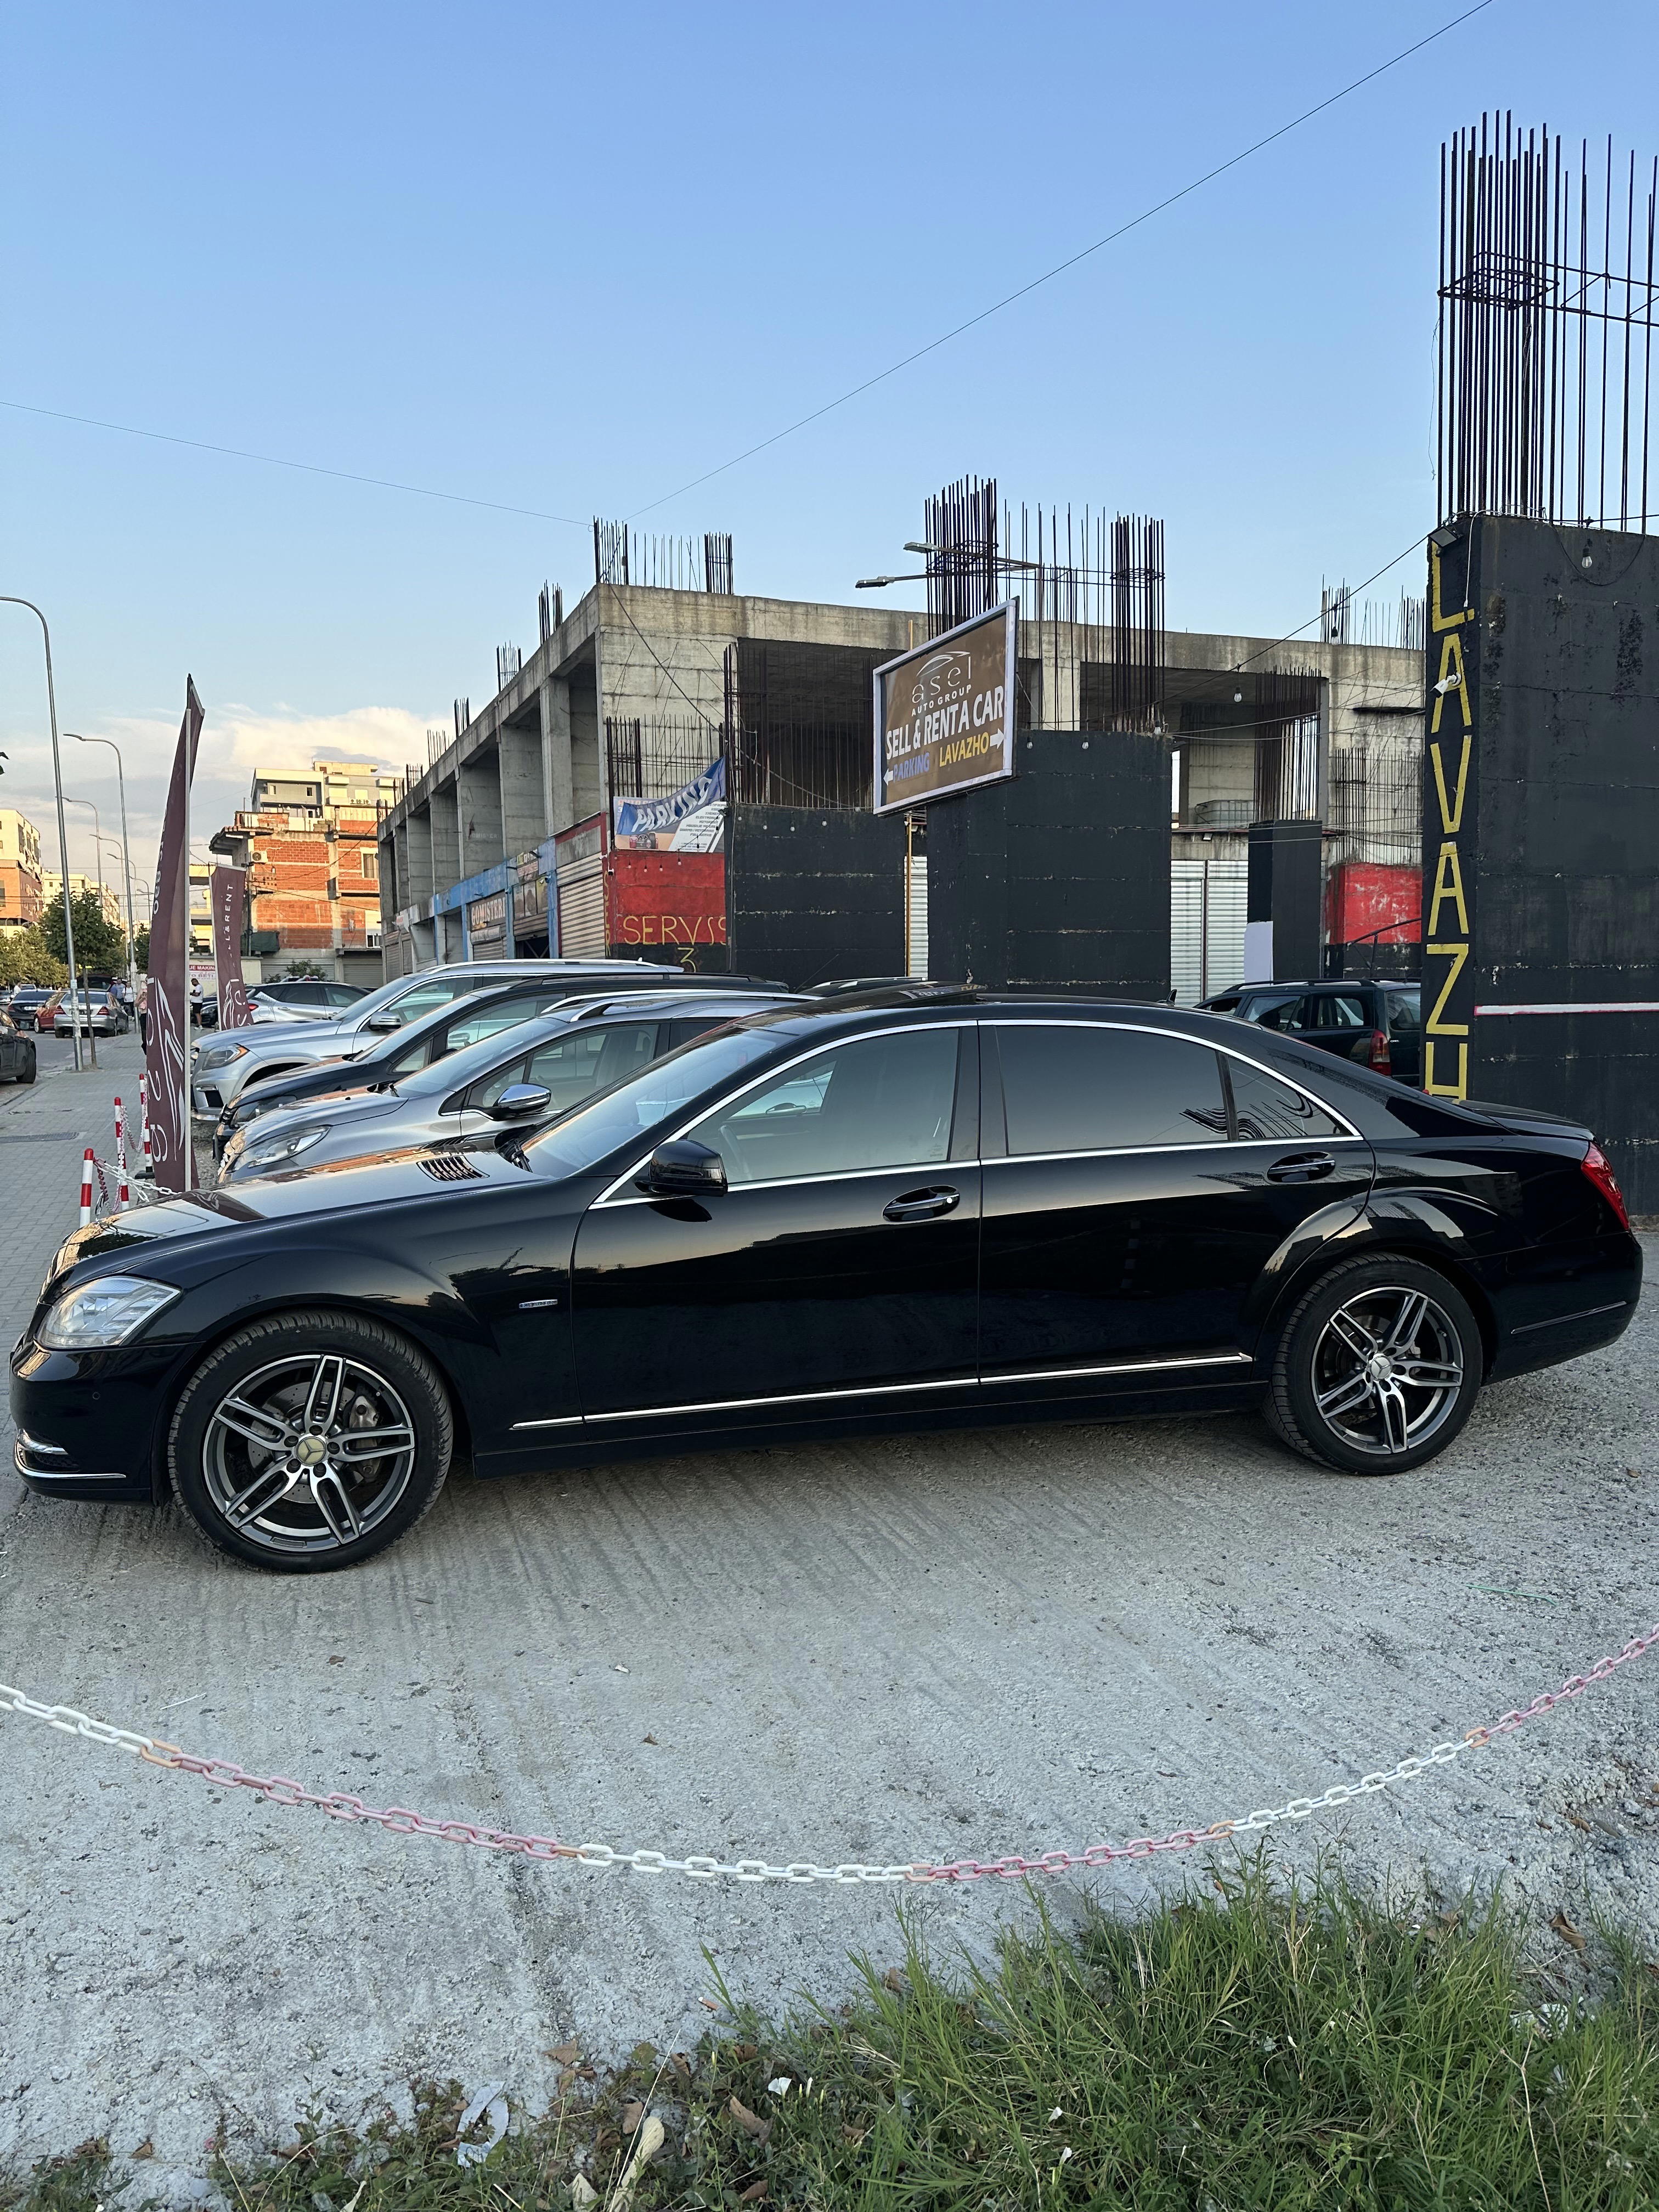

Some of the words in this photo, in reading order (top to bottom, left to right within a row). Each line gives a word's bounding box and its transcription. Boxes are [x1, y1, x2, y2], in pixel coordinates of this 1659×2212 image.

[911, 656, 971, 704] asel
[911, 700, 934, 717] AUTO
[938, 684, 972, 705] GROUP
[886, 724, 911, 760] SELL
[913, 719, 921, 750] &
[973, 685, 1004, 727] CAR
[893, 752, 930, 783] PARKING
[939, 732, 989, 767] LAVAZHO
[631, 776, 713, 833] PARKING
[471, 896, 505, 926] GOMISTERI
